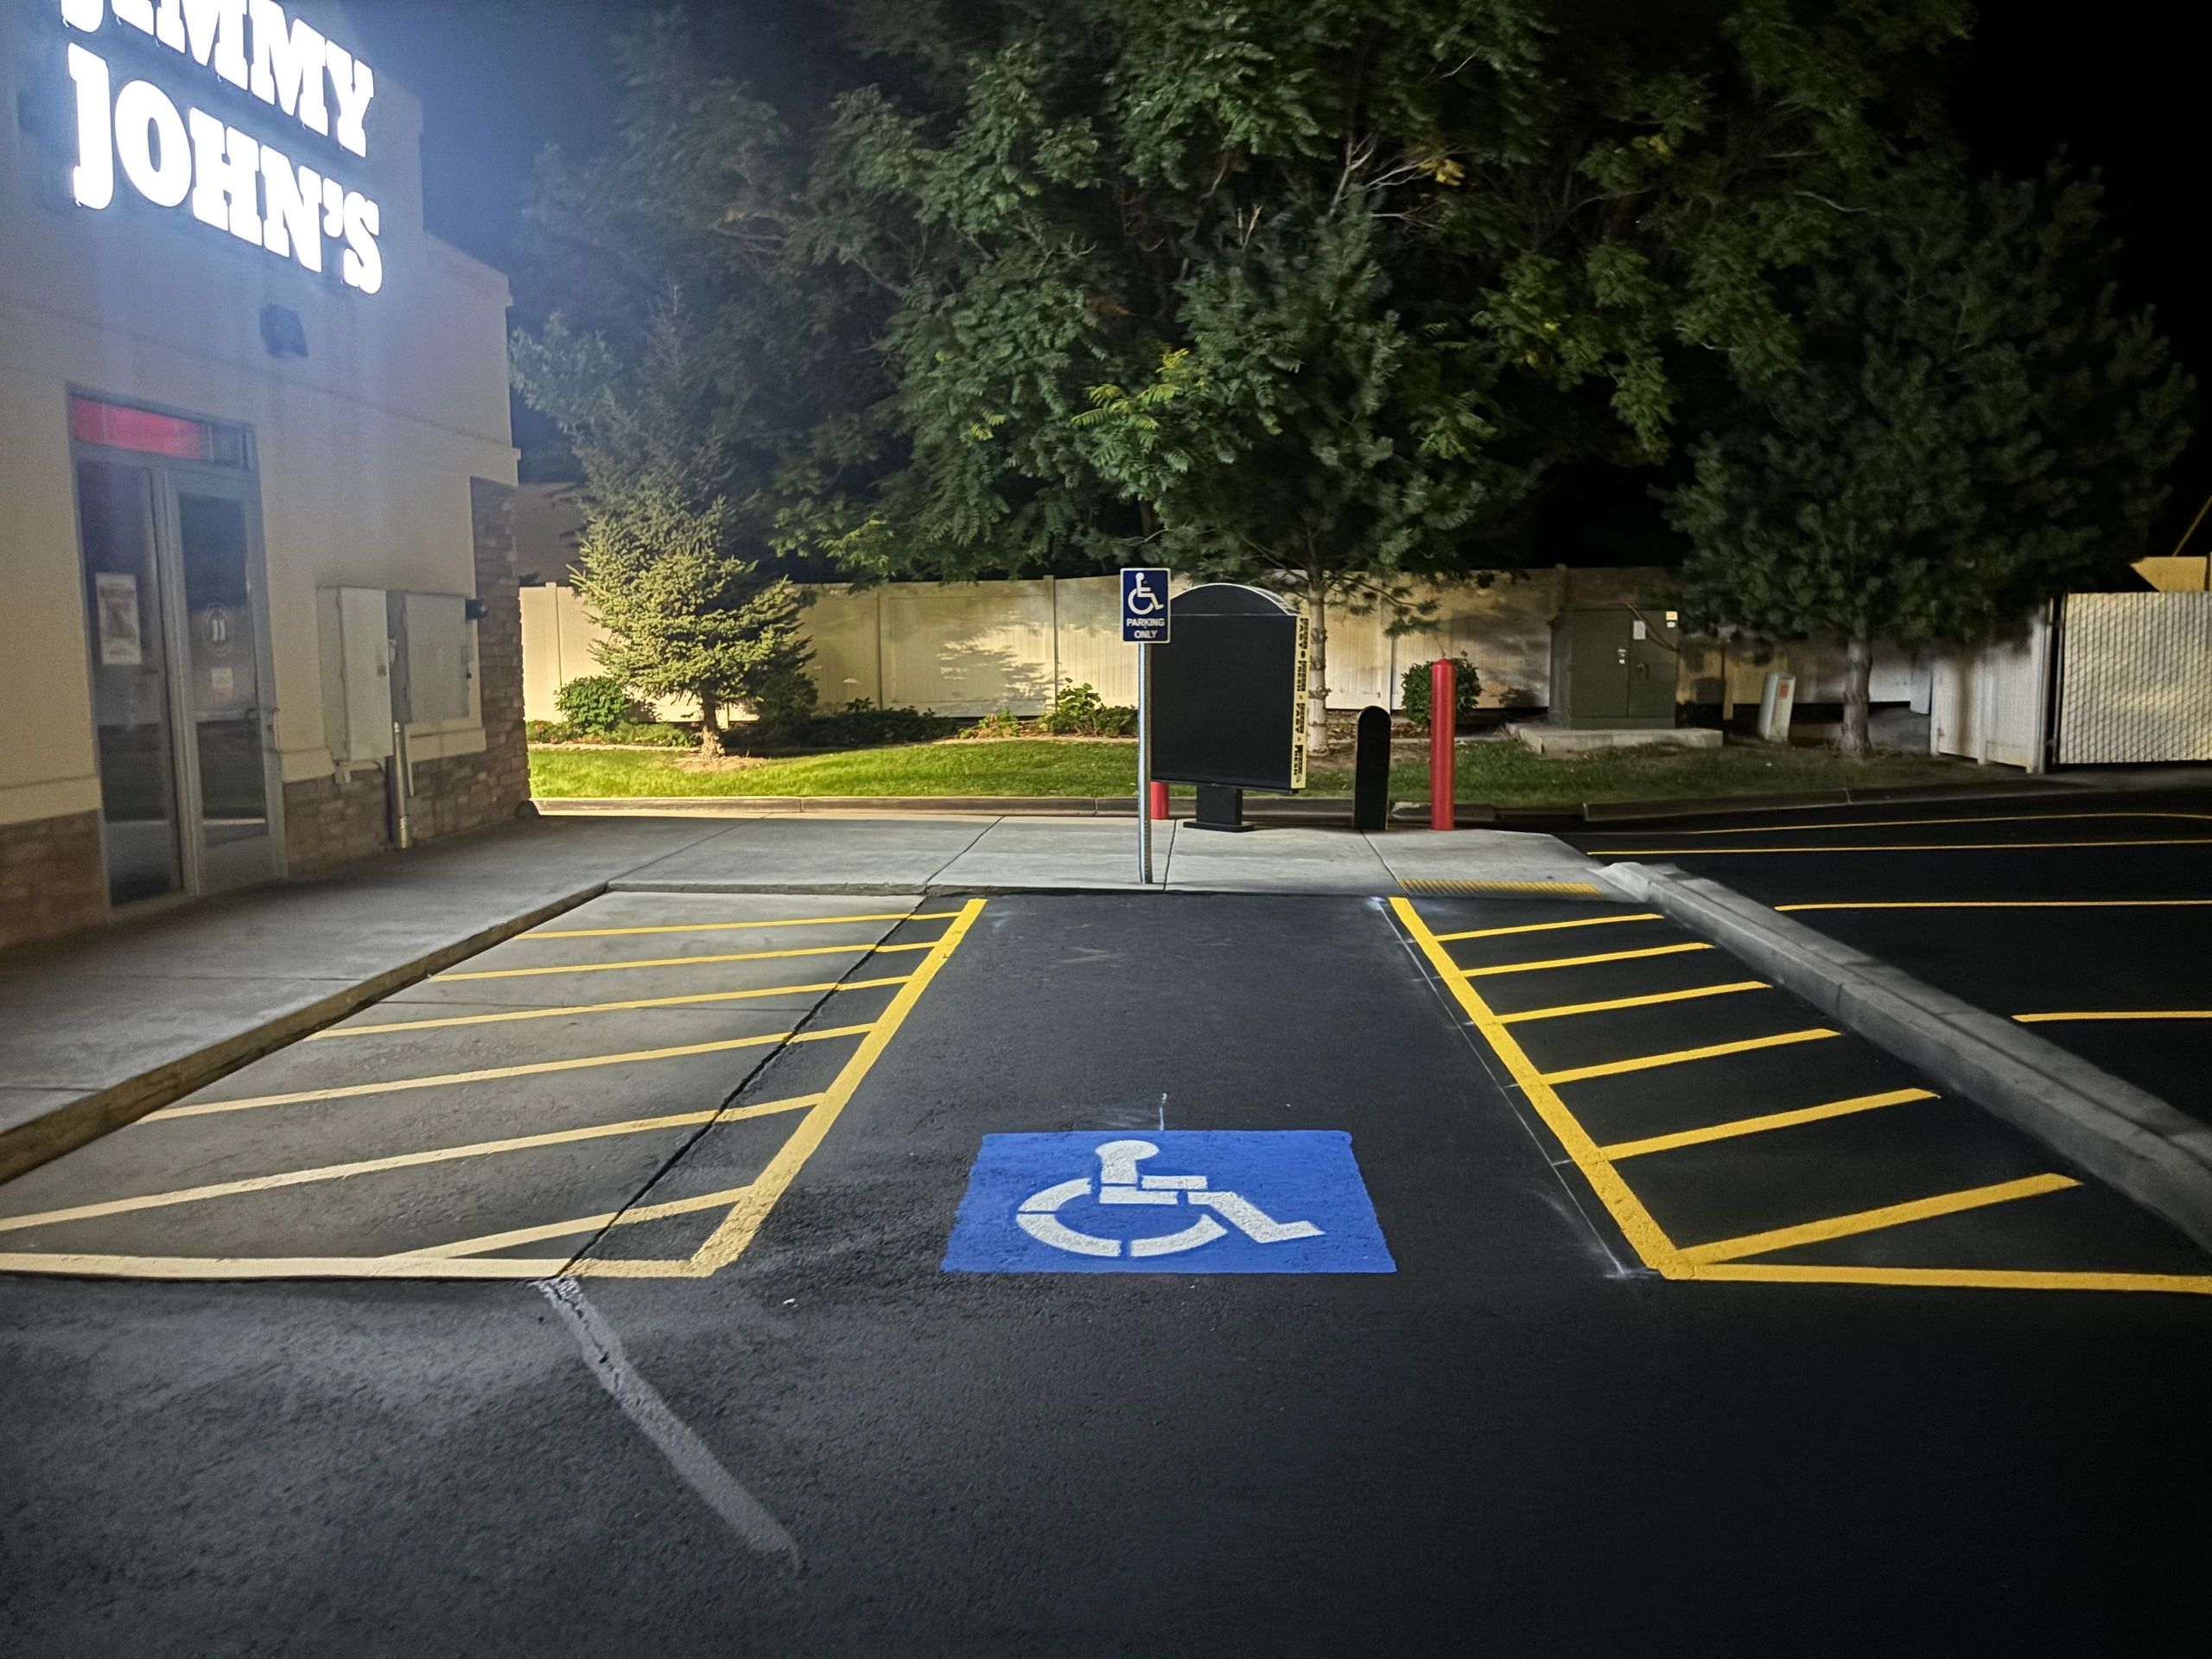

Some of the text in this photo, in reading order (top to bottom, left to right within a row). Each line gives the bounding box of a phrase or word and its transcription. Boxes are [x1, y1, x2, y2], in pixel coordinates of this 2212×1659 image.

[61, 0, 374, 158] MMY
[67, 42, 383, 295] JOHN'S
[1126, 618, 1166, 626] PARKING
[1134, 630, 1158, 639] ONLY
